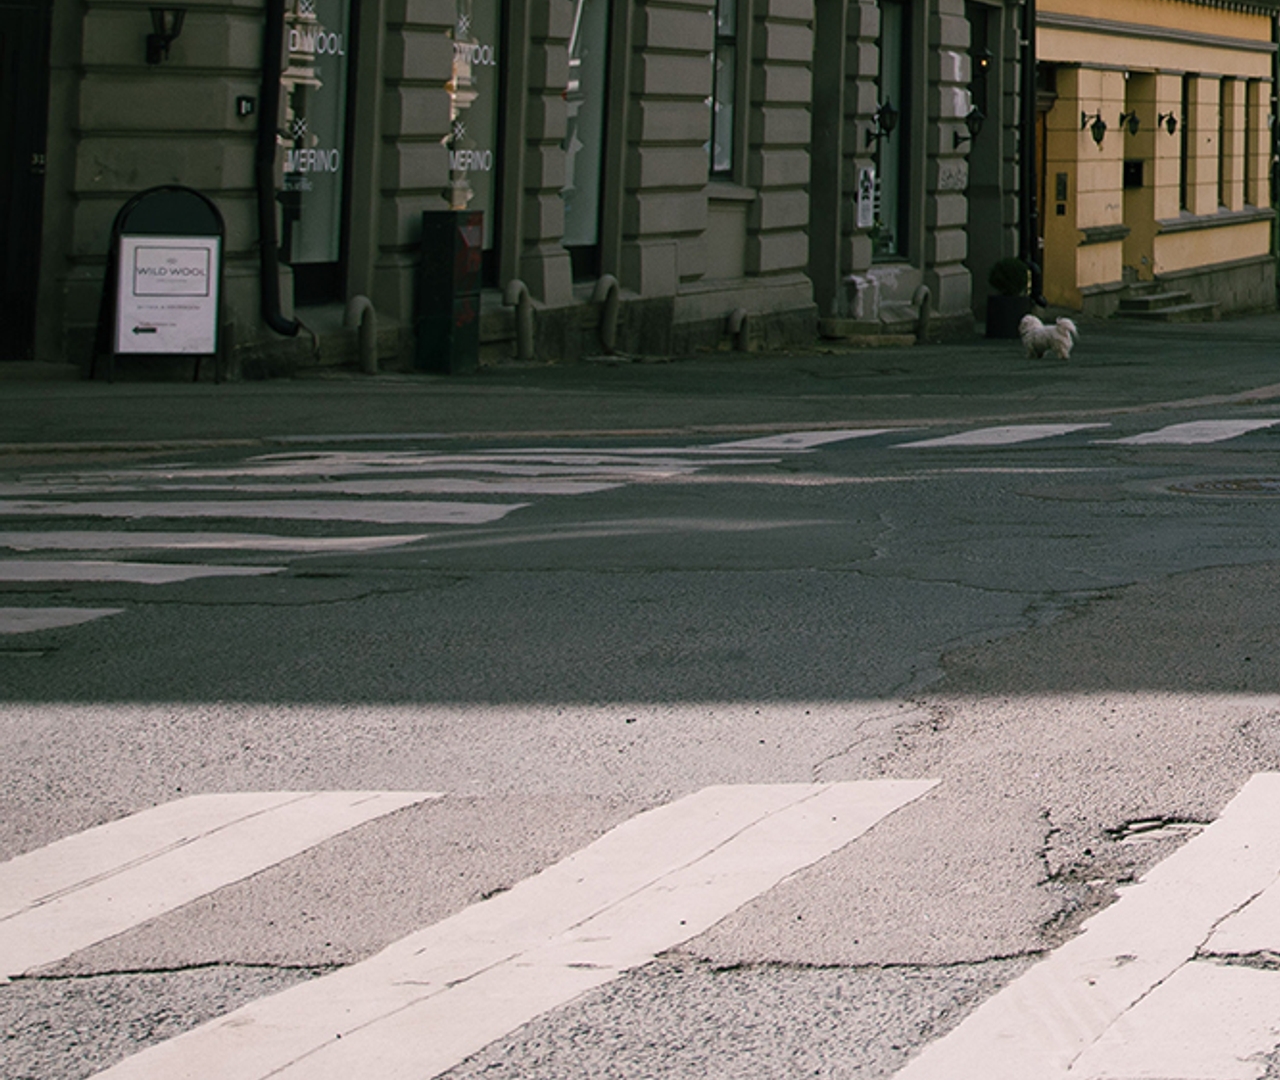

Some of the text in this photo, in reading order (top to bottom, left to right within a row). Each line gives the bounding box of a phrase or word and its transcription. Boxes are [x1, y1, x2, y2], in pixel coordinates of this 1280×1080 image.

[286, 148, 340, 173] MERINO
[137, 266, 206, 277] WILD WOOL
